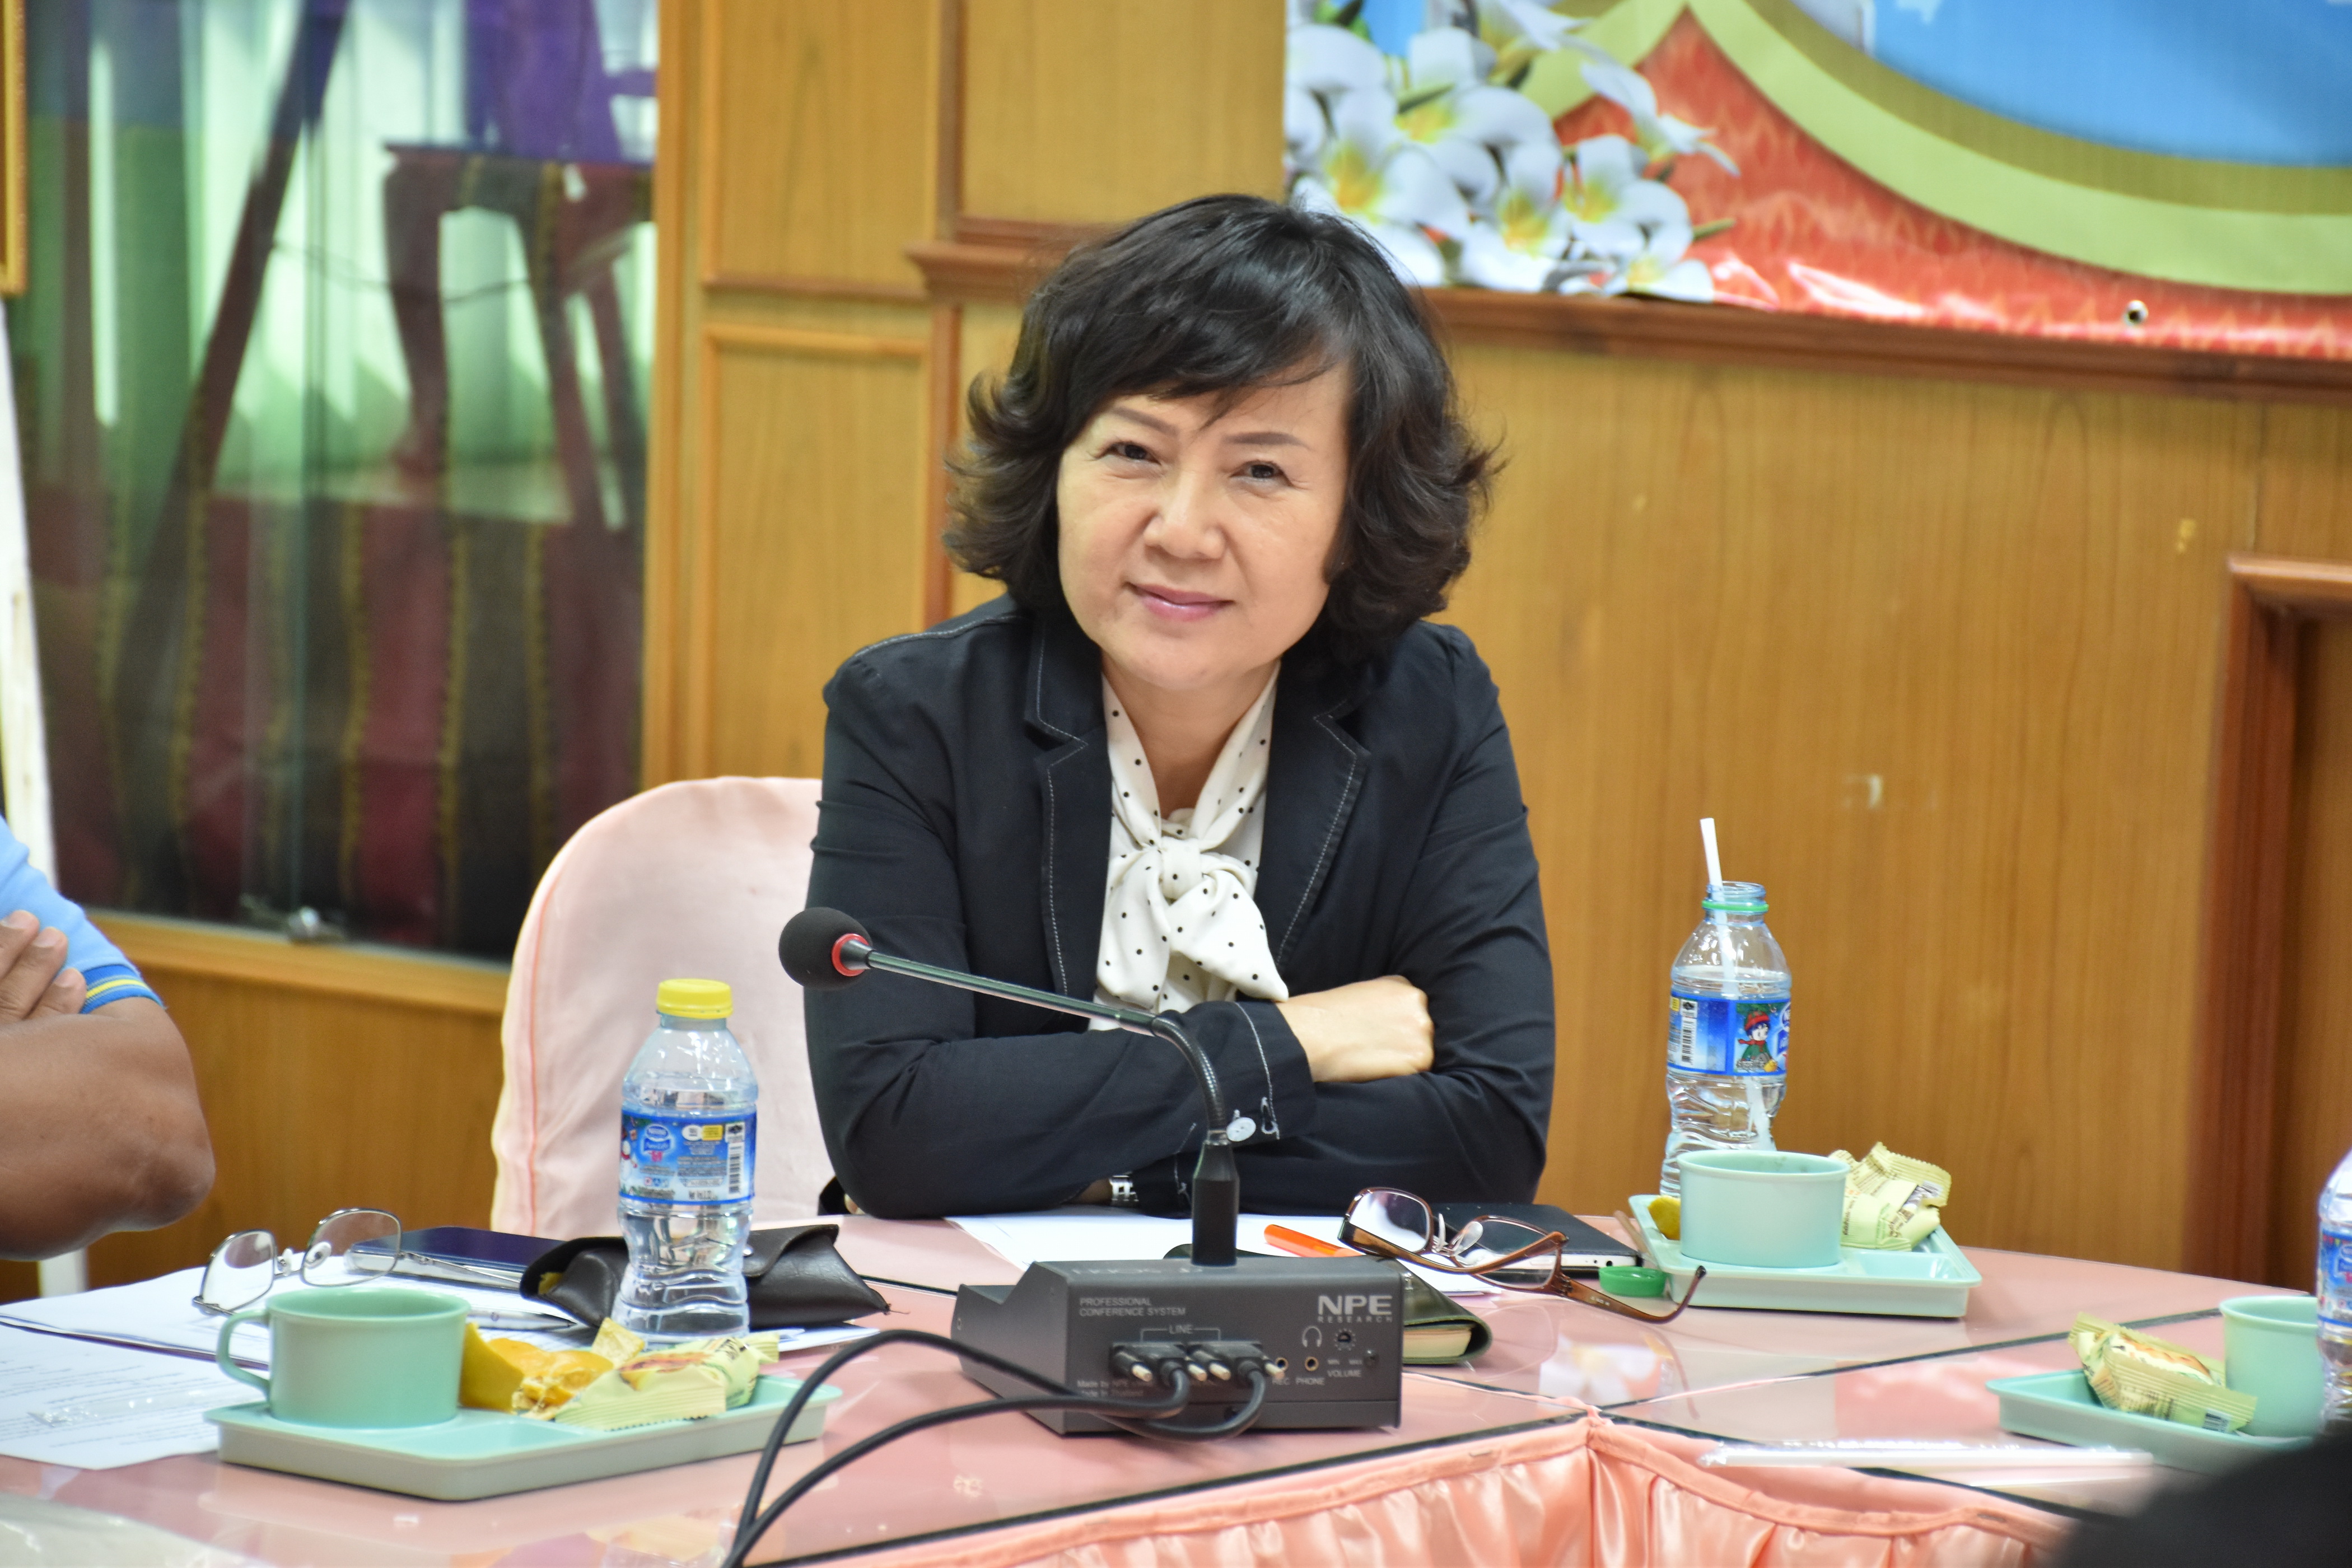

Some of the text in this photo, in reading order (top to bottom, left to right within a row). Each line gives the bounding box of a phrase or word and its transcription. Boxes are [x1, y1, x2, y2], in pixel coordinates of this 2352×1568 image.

[1079, 1298, 1151, 1306] PROFESSIONAL
[1318, 1295, 1393, 1315] NPE
[1079, 1307, 1186, 1316] CONFERENCE SYSTEM
[1168, 1324, 1193, 1334] LINE
[1295, 1377, 1325, 1385] PHONE
